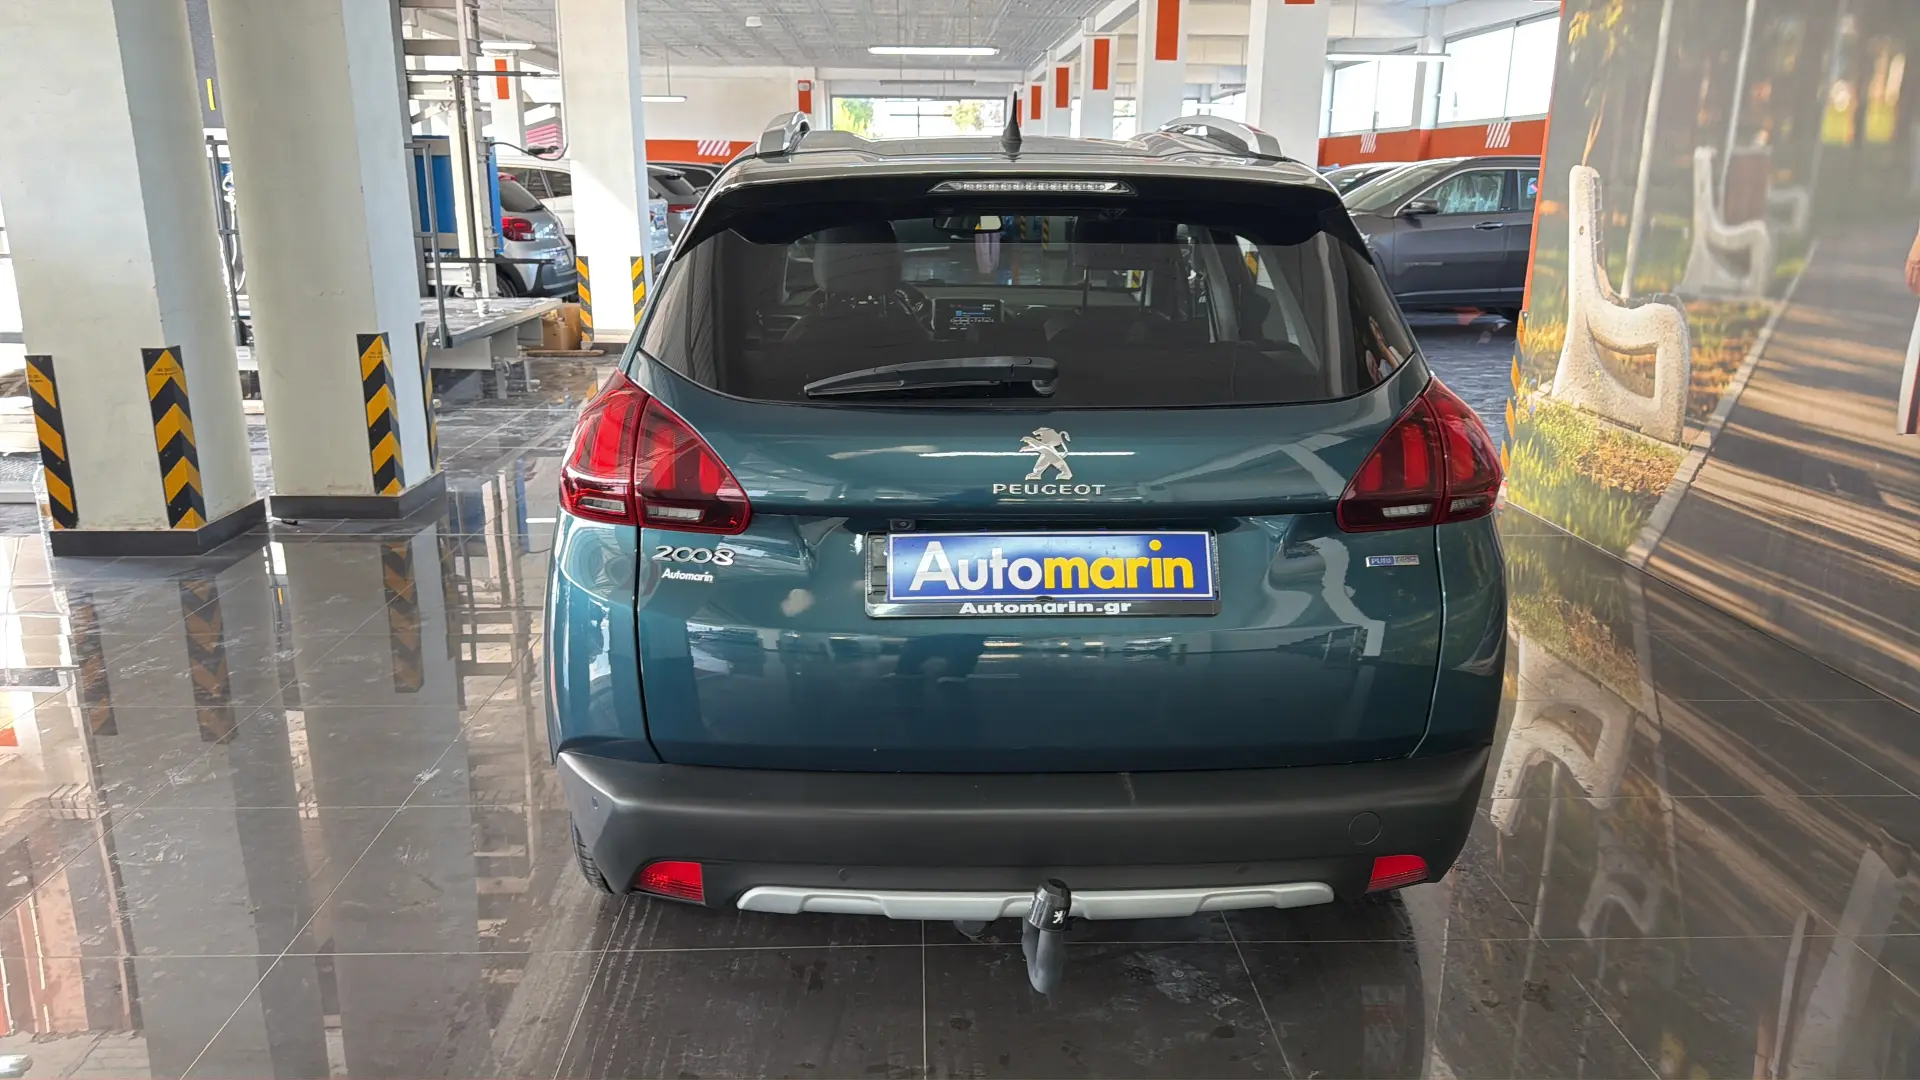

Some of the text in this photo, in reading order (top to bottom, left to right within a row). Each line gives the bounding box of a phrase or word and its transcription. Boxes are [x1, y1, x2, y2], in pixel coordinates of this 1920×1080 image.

[992, 483, 1106, 495] PEUGEOT
[652, 545, 735, 566] 2008
[909, 540, 1193, 591] Automarin
[661, 567, 714, 583] Automarin
[959, 602, 1132, 614] Automarin.gr
